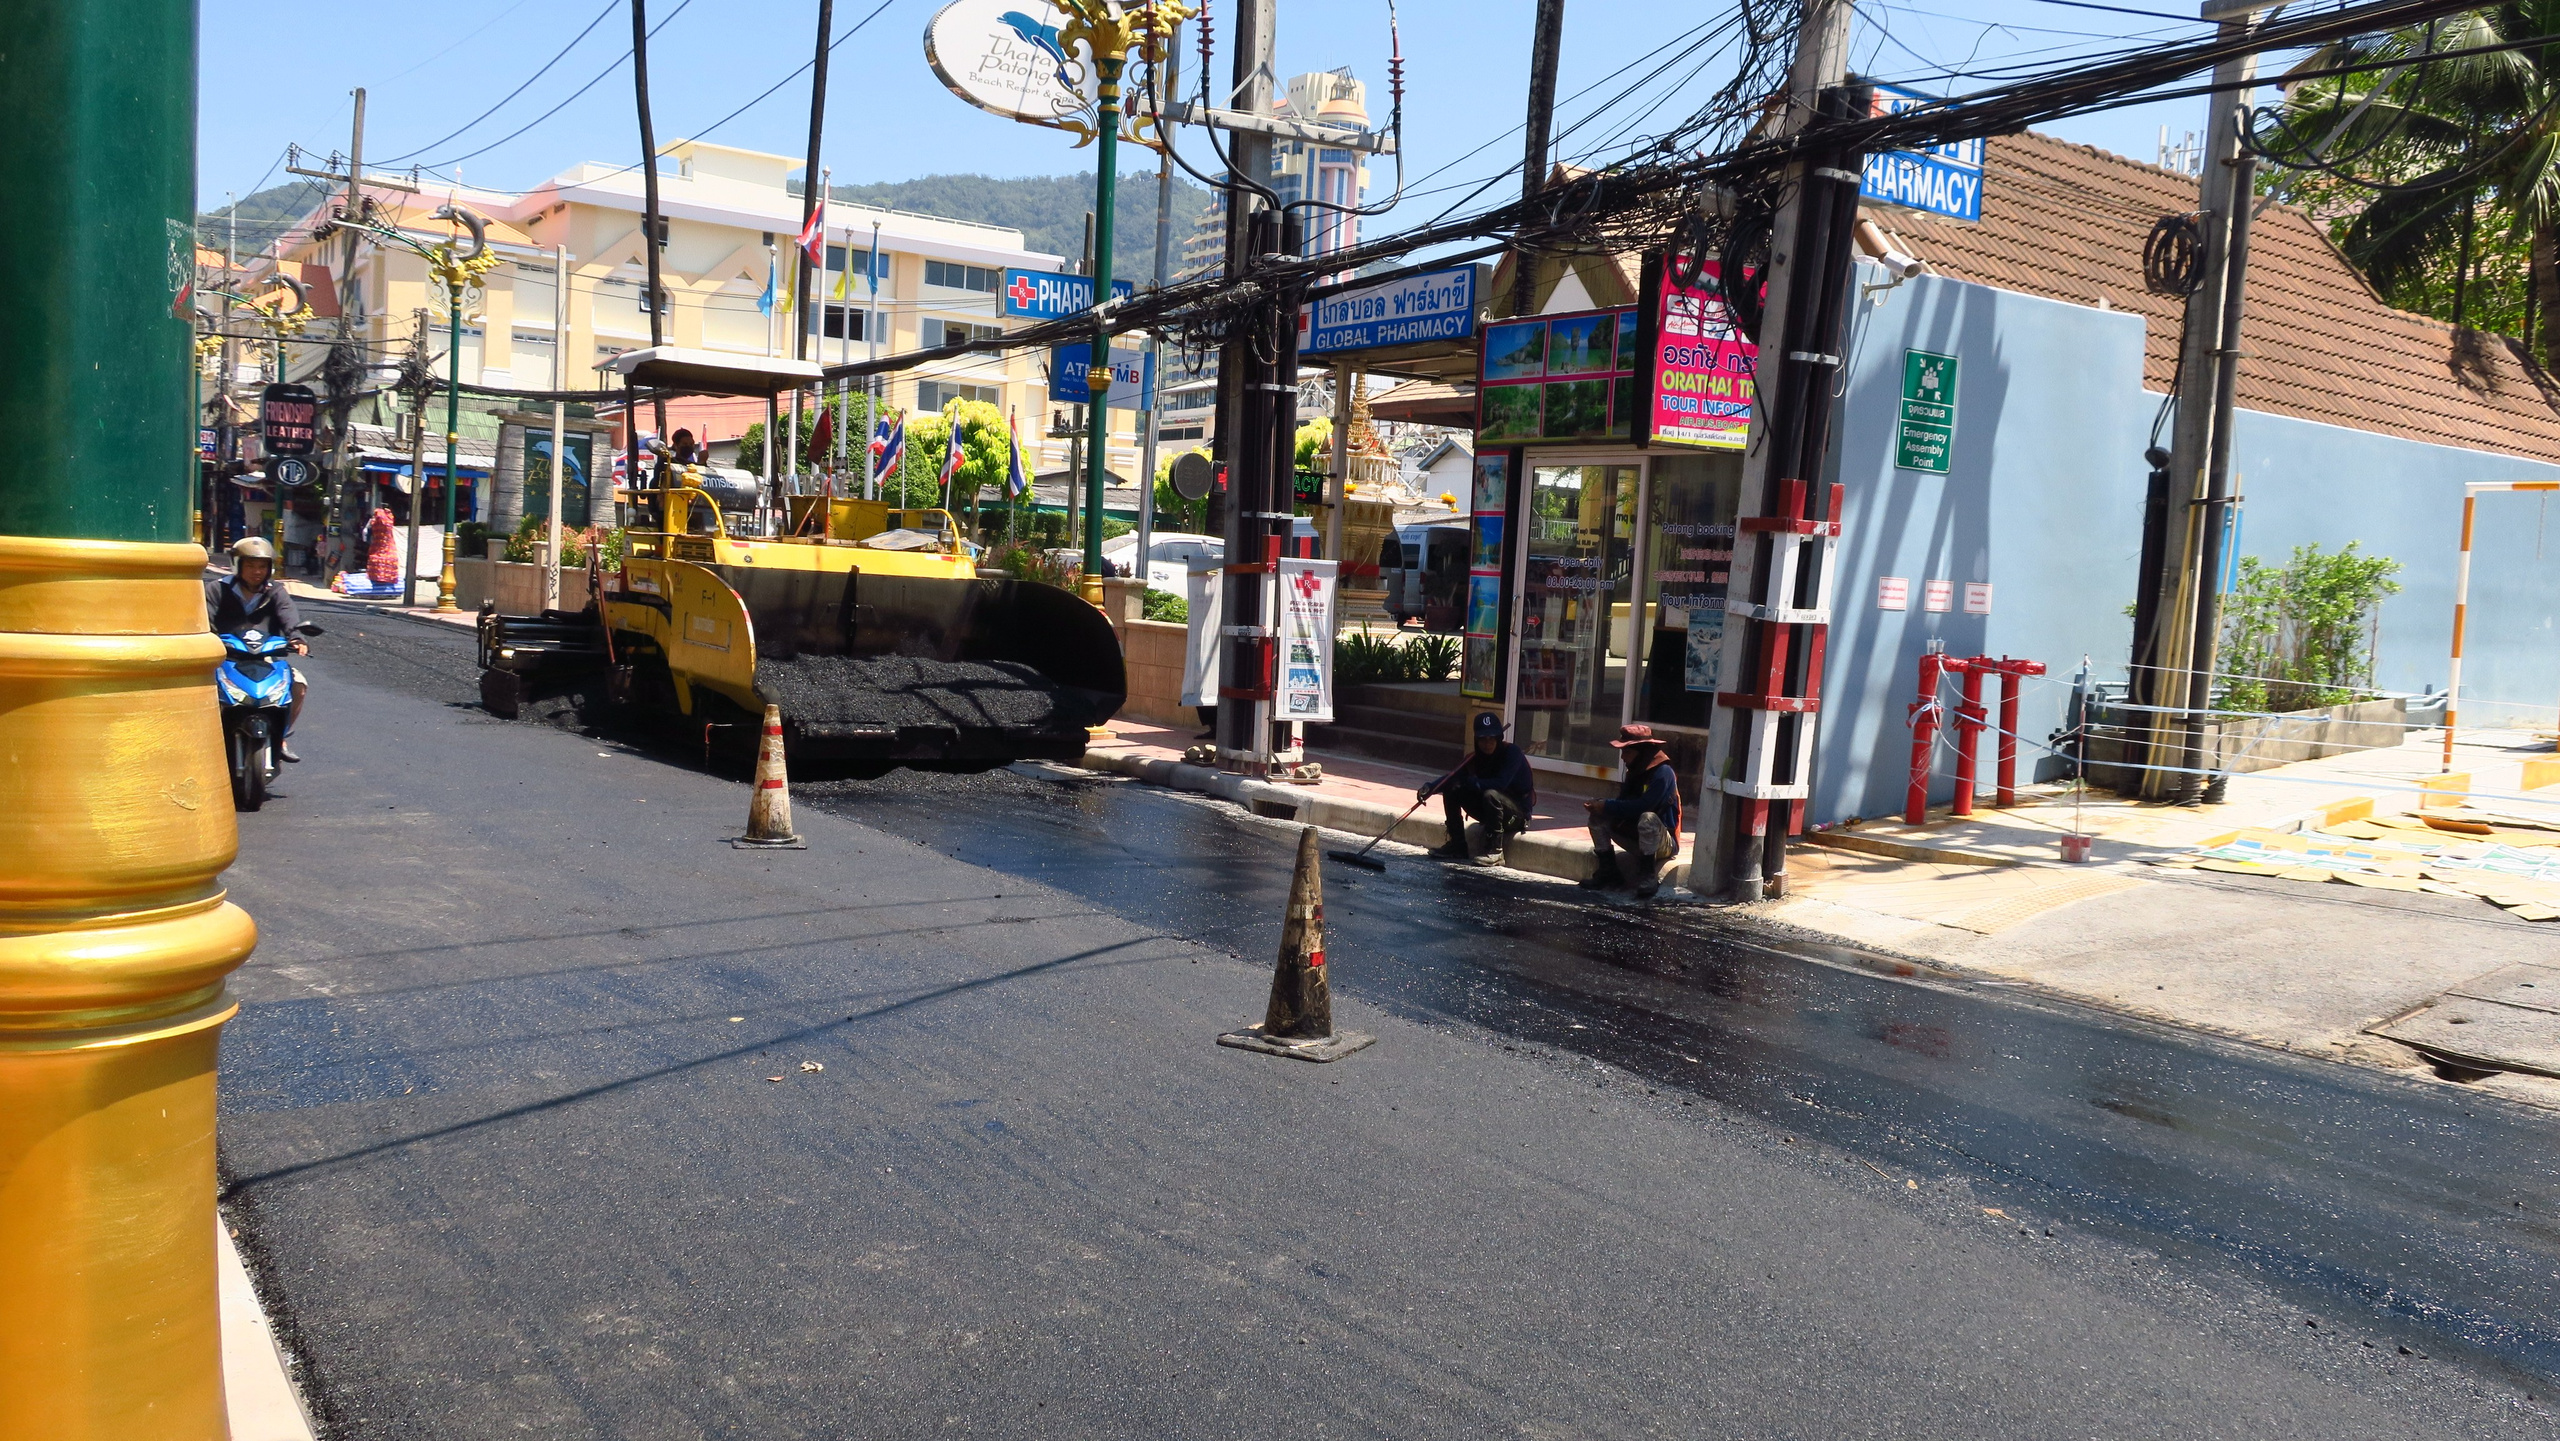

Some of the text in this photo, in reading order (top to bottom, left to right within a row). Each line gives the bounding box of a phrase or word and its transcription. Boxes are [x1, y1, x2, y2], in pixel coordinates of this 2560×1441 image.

[988, 33, 1052, 67] Thara
[979, 54, 1051, 86] Patong
[968, 71, 1074, 104] Beach Resort & Spa
[1393, 273, 1466, 315] ฟาร์มาซี
[1316, 315, 1466, 350] GLOBAL PHARMACY
[1661, 369, 1733, 397] ORATHAI
[265, 400, 315, 424] FRIENDSHIP
[1661, 395, 1698, 413] TOUR
[266, 425, 313, 440] LEATHER
[1903, 426, 1948, 444] Emergency
[1905, 441, 1944, 458] Assembly
[1912, 455, 1935, 468] Point
[1662, 522, 1735, 538] Patong booking
[1558, 556, 1604, 569] Open daily
[1600, 580, 1615, 590] pm
[702, 589, 716, 607] F-1
[1661, 593, 1726, 609] Tour inform
